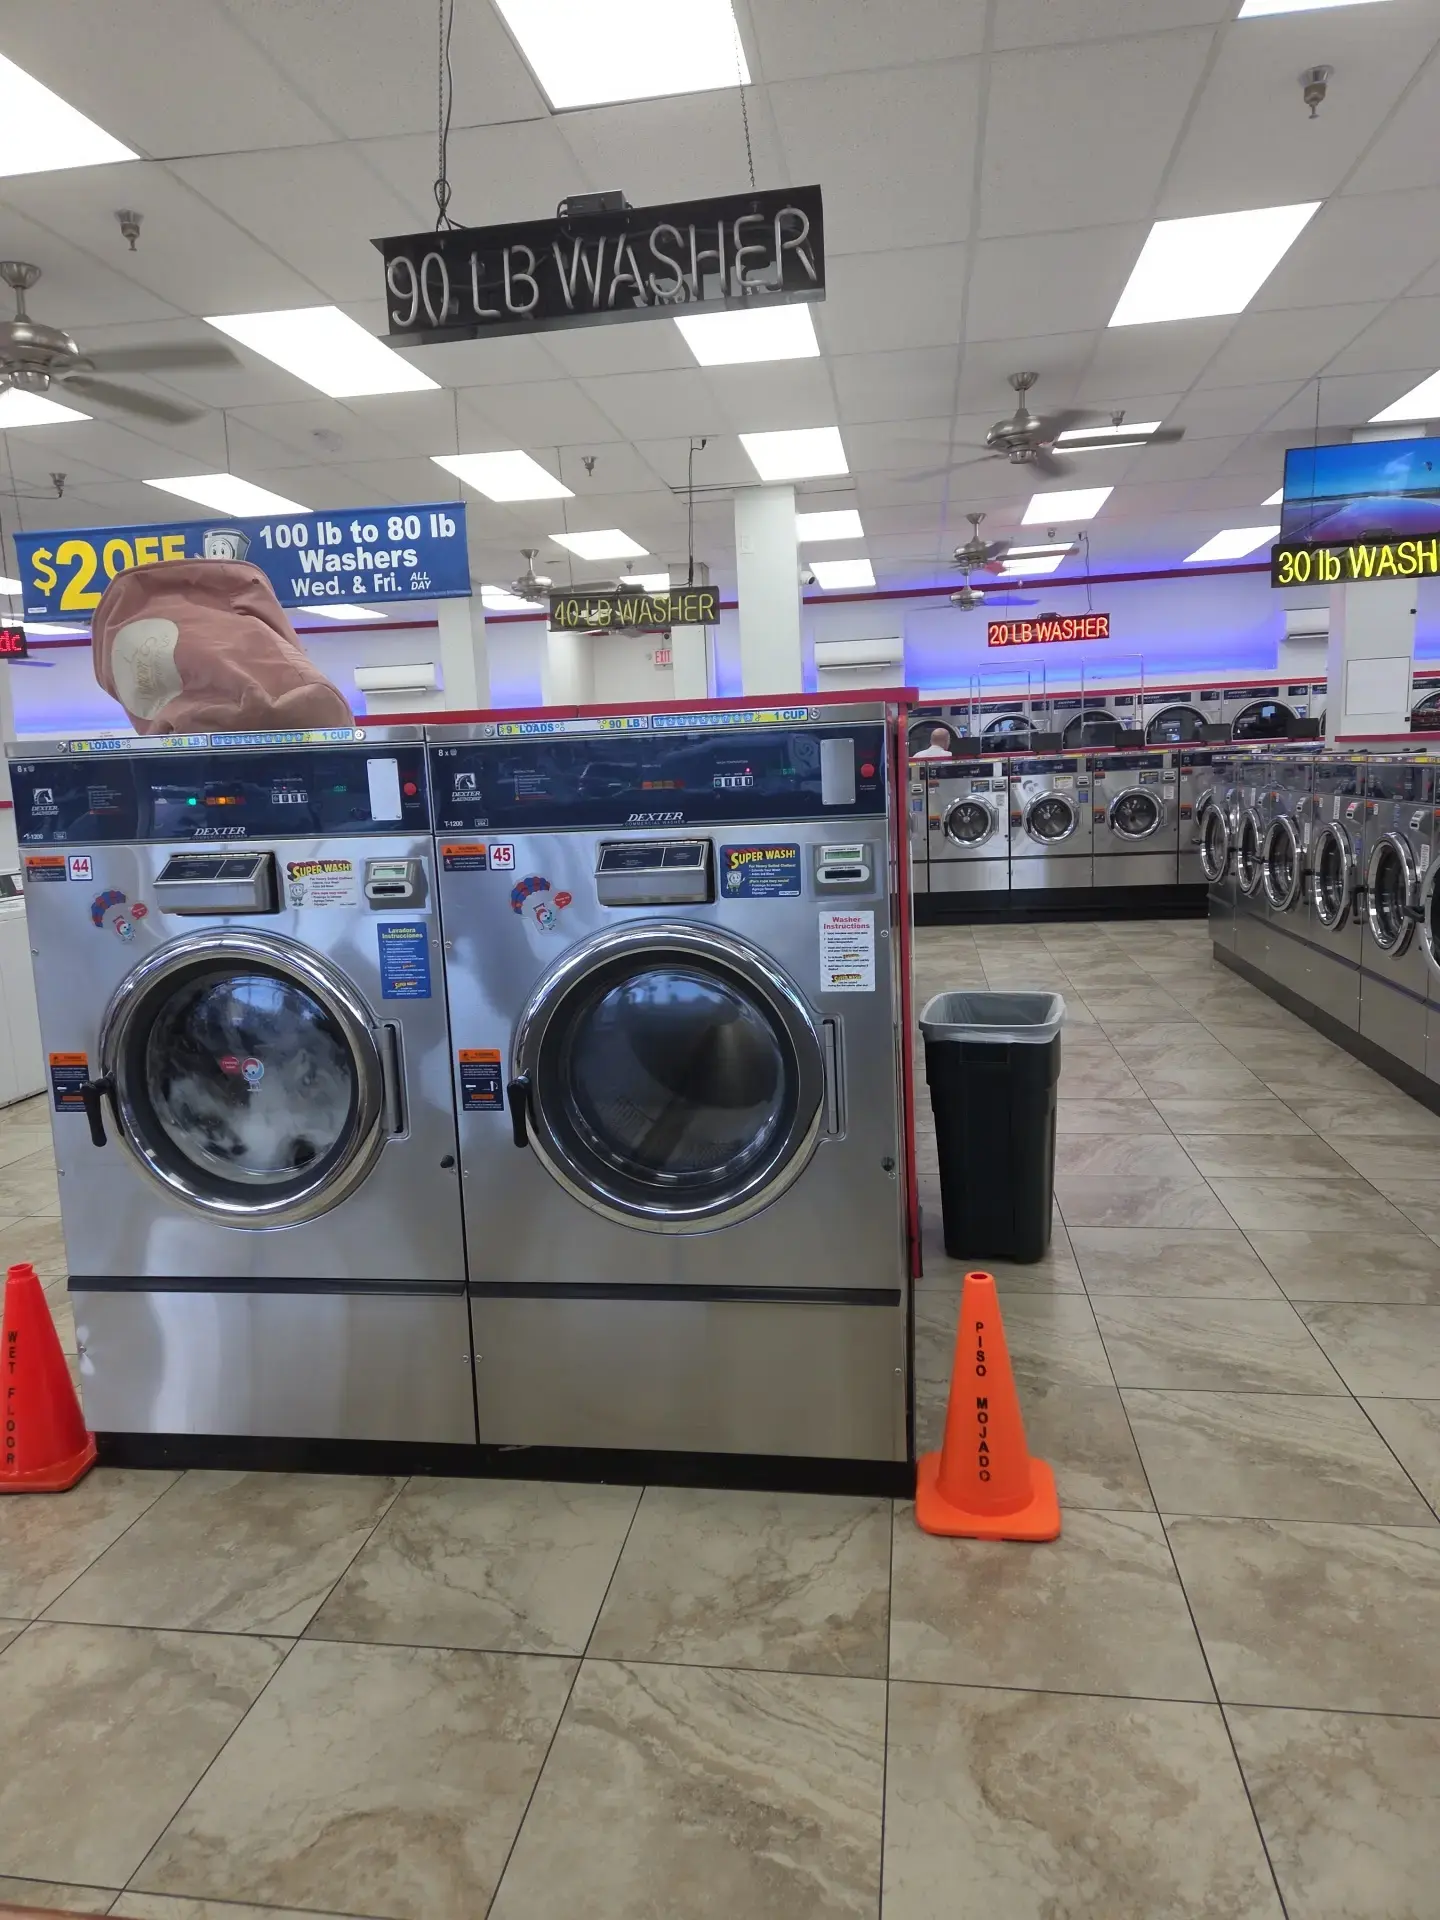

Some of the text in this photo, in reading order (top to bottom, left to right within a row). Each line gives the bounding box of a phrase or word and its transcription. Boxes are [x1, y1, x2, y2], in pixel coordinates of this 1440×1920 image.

[387, 207, 818, 328] 90 LB WASHER
[260, 513, 456, 549] 100 lb to 80 lb
[298, 546, 418, 573] Washers
[1278, 550, 1311, 584] 30
[1319, 548, 1341, 582] lb
[31, 540, 103, 611] $2
[291, 572, 402, 598] Wed. & Fri.
[410, 572, 429, 581] ALL
[411, 580, 432, 591] DAY
[554, 593, 715, 627] 40 LB WASHER
[989, 616, 1109, 645] 20 LB WASHER
[655, 650, 671, 663] EXIT
[774, 710, 805, 721] 1 CUP
[322, 729, 351, 740] 1 CUP
[506, 718, 641, 734] 9 LOADS 90 LB
[76, 737, 200, 751] 9 LOADS 90 LB
[627, 811, 684, 824] DEXTER
[194, 826, 247, 836] DEXTER
[493, 847, 511, 862] 45
[731, 849, 796, 870] SUPER WASH!
[72, 858, 89, 872] 44
[292, 864, 322, 883] SUPER
[6, 1331, 17, 1465] WET FLOOR
[975, 1321, 991, 1483] PISO MOJADO
